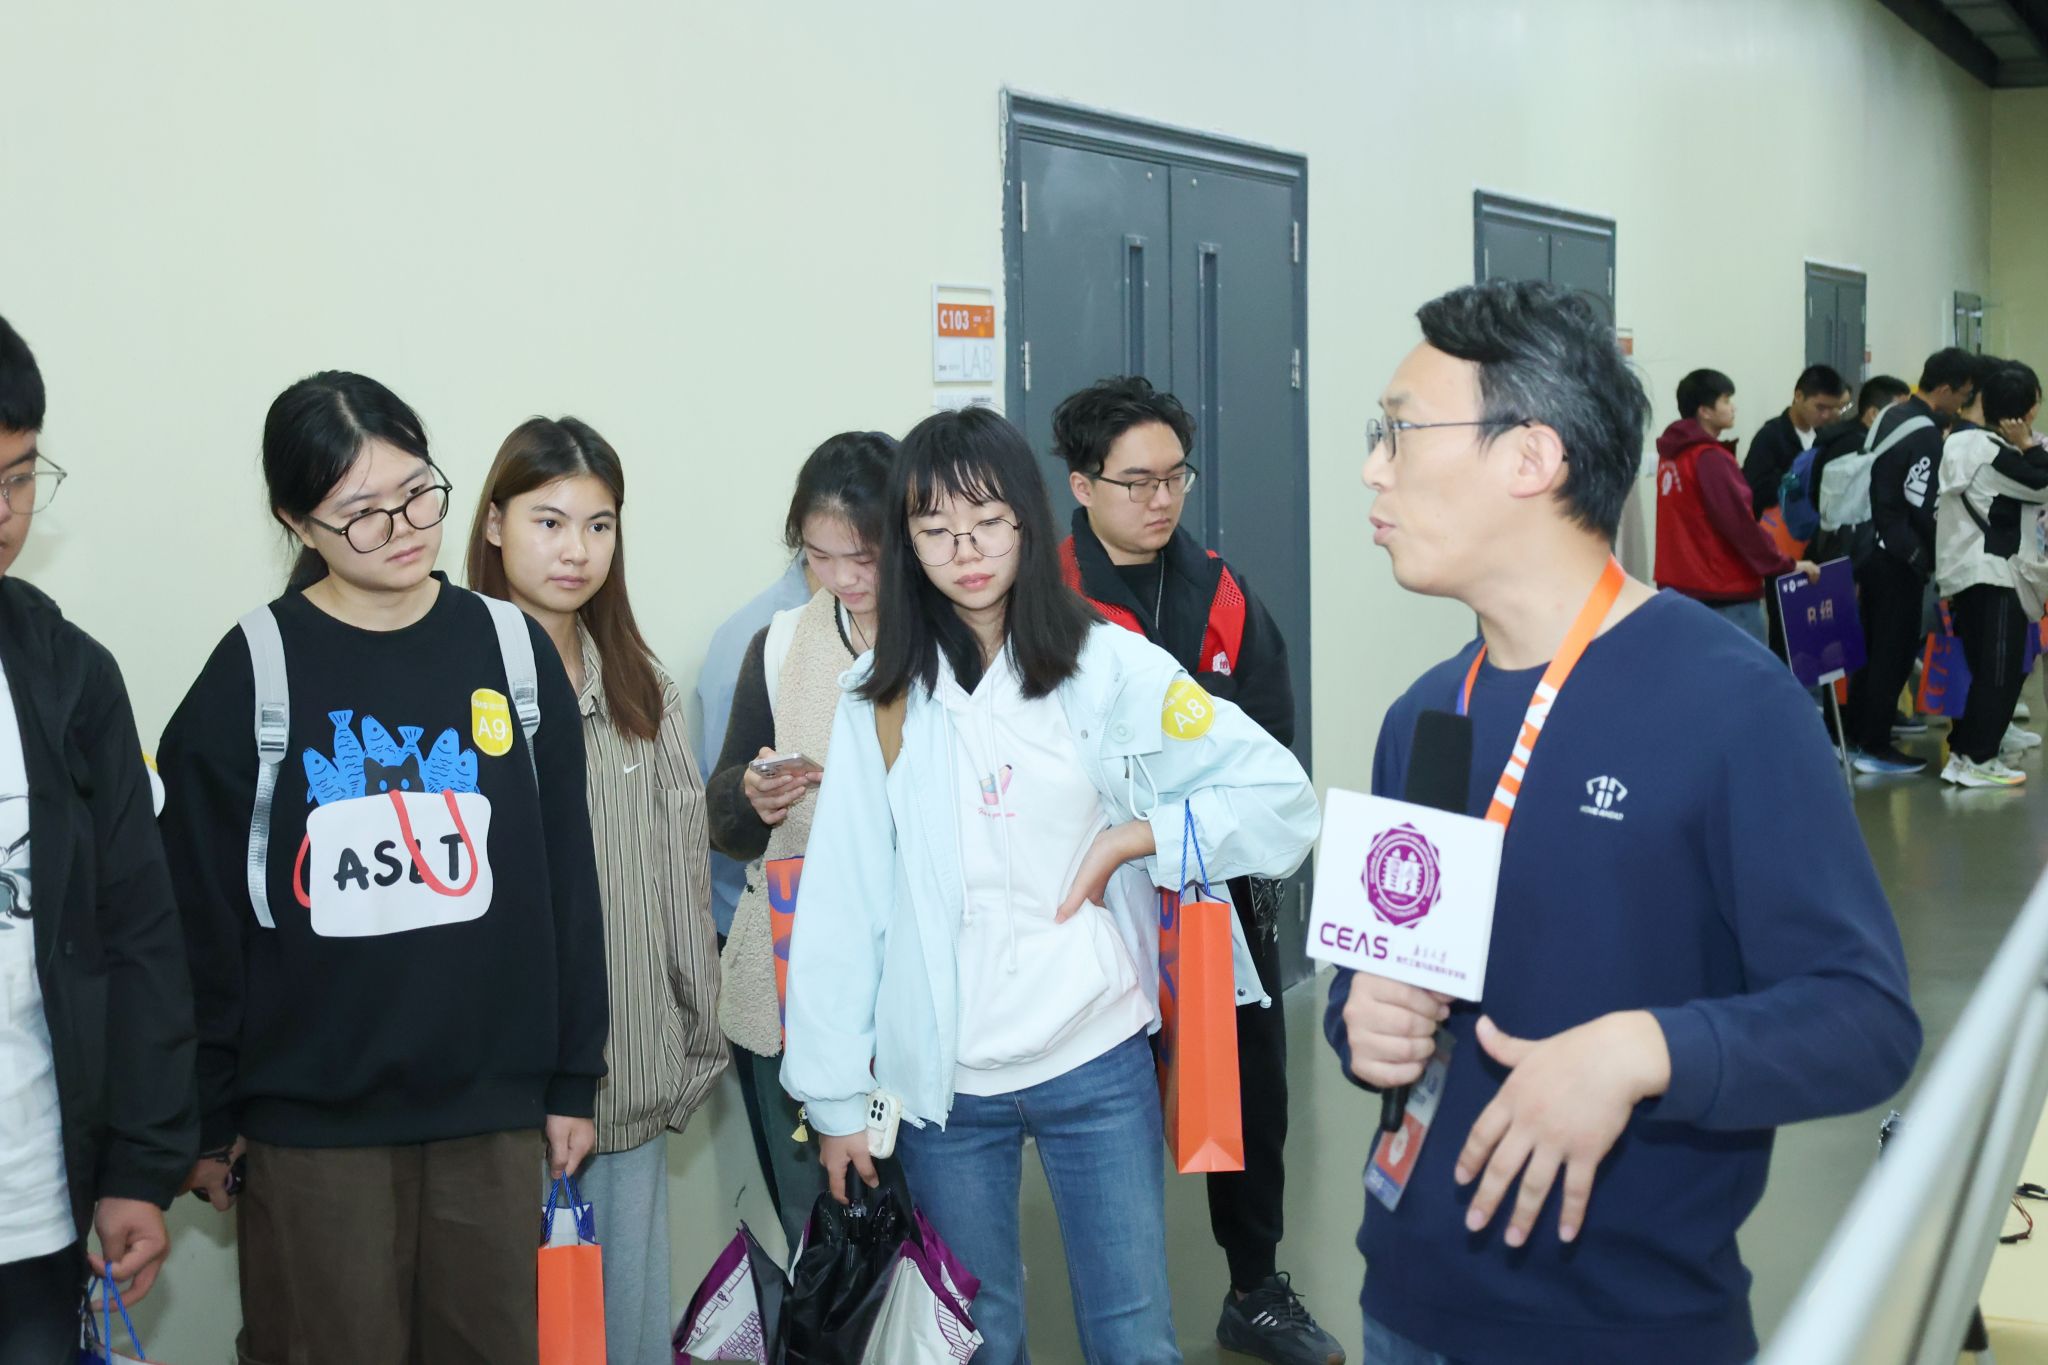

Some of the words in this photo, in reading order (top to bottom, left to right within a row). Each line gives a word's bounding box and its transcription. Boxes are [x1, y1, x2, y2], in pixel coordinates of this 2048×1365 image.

[940, 309, 970, 330] C103
[962, 344, 993, 378] LAB
[477, 715, 507, 741] A9
[1174, 698, 1206, 734] A8
[1319, 921, 1389, 960] CEAS
